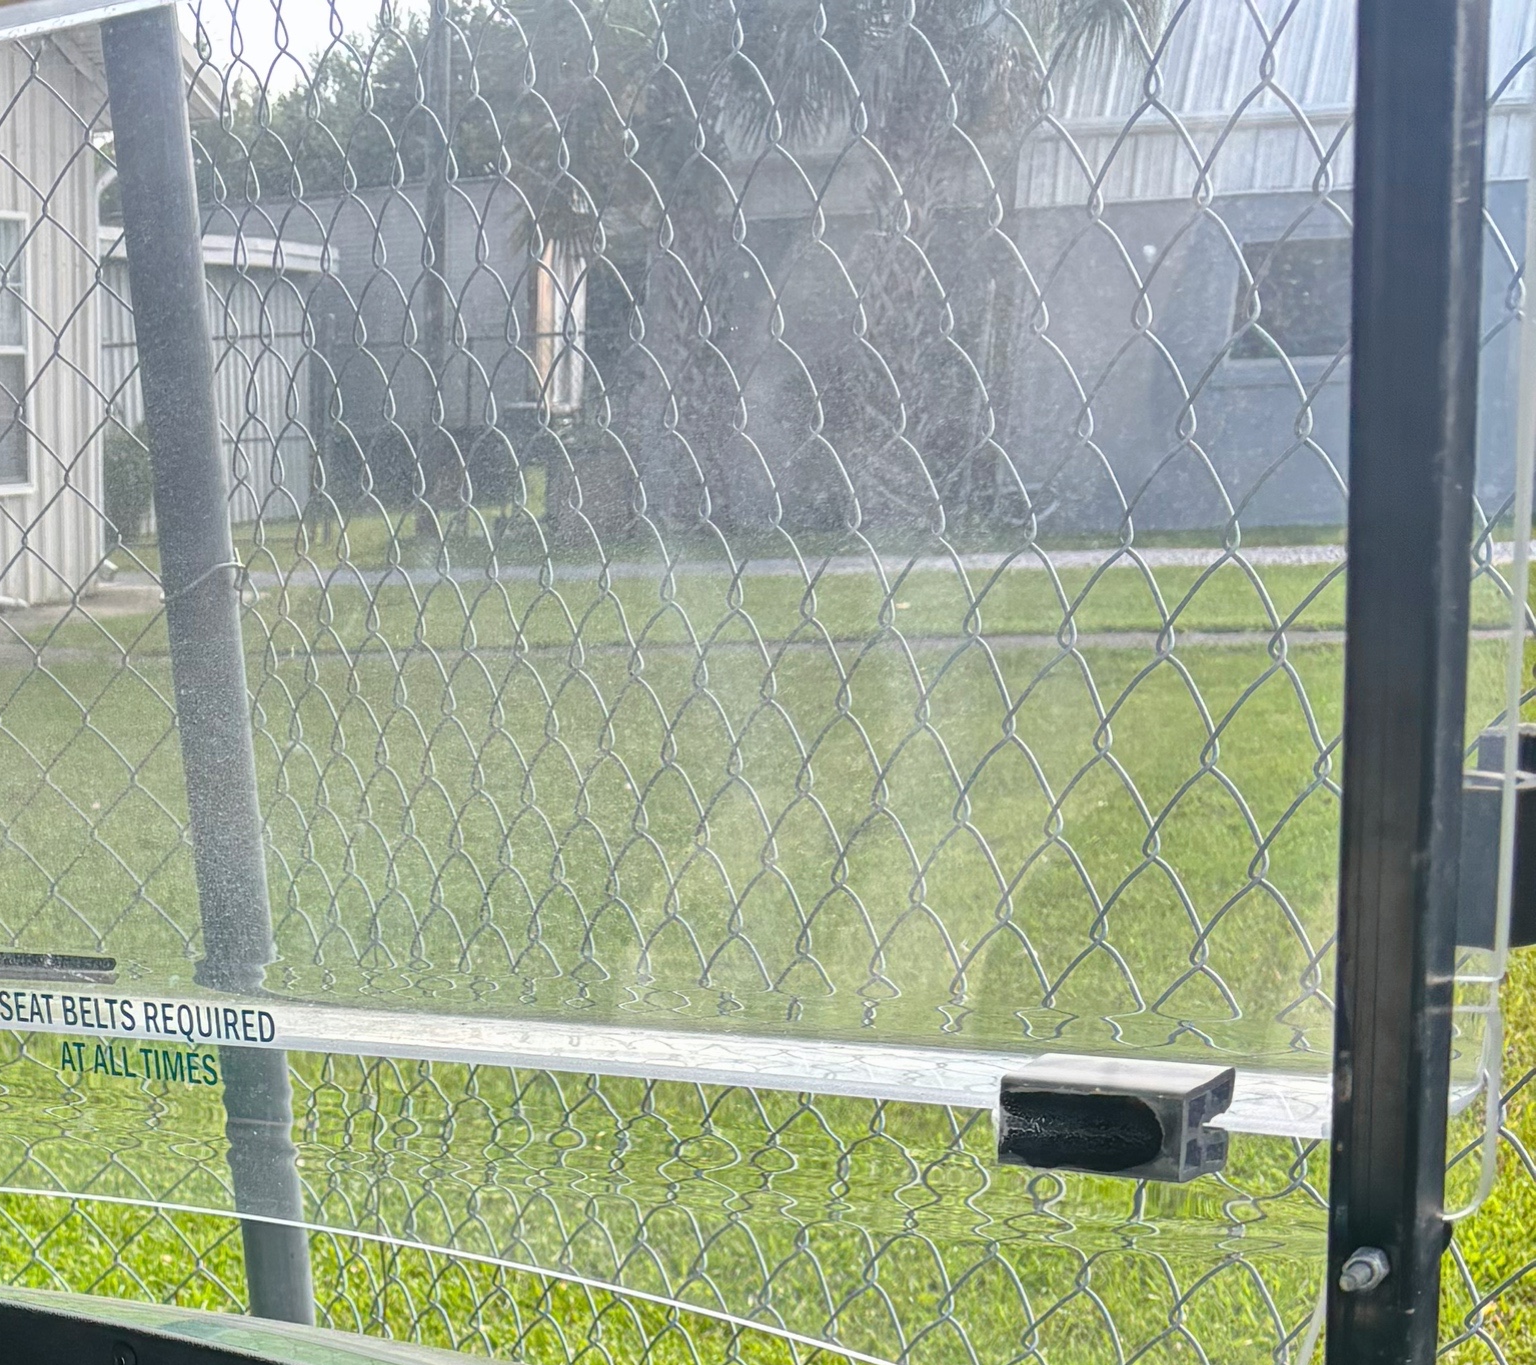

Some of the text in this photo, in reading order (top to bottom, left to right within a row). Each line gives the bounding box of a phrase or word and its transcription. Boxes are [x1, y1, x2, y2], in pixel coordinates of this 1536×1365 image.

[62, 995, 136, 1031] BELTS
[143, 1001, 276, 1043] REQUIRED
[60, 1040, 218, 1086] AT ALL TIMES
